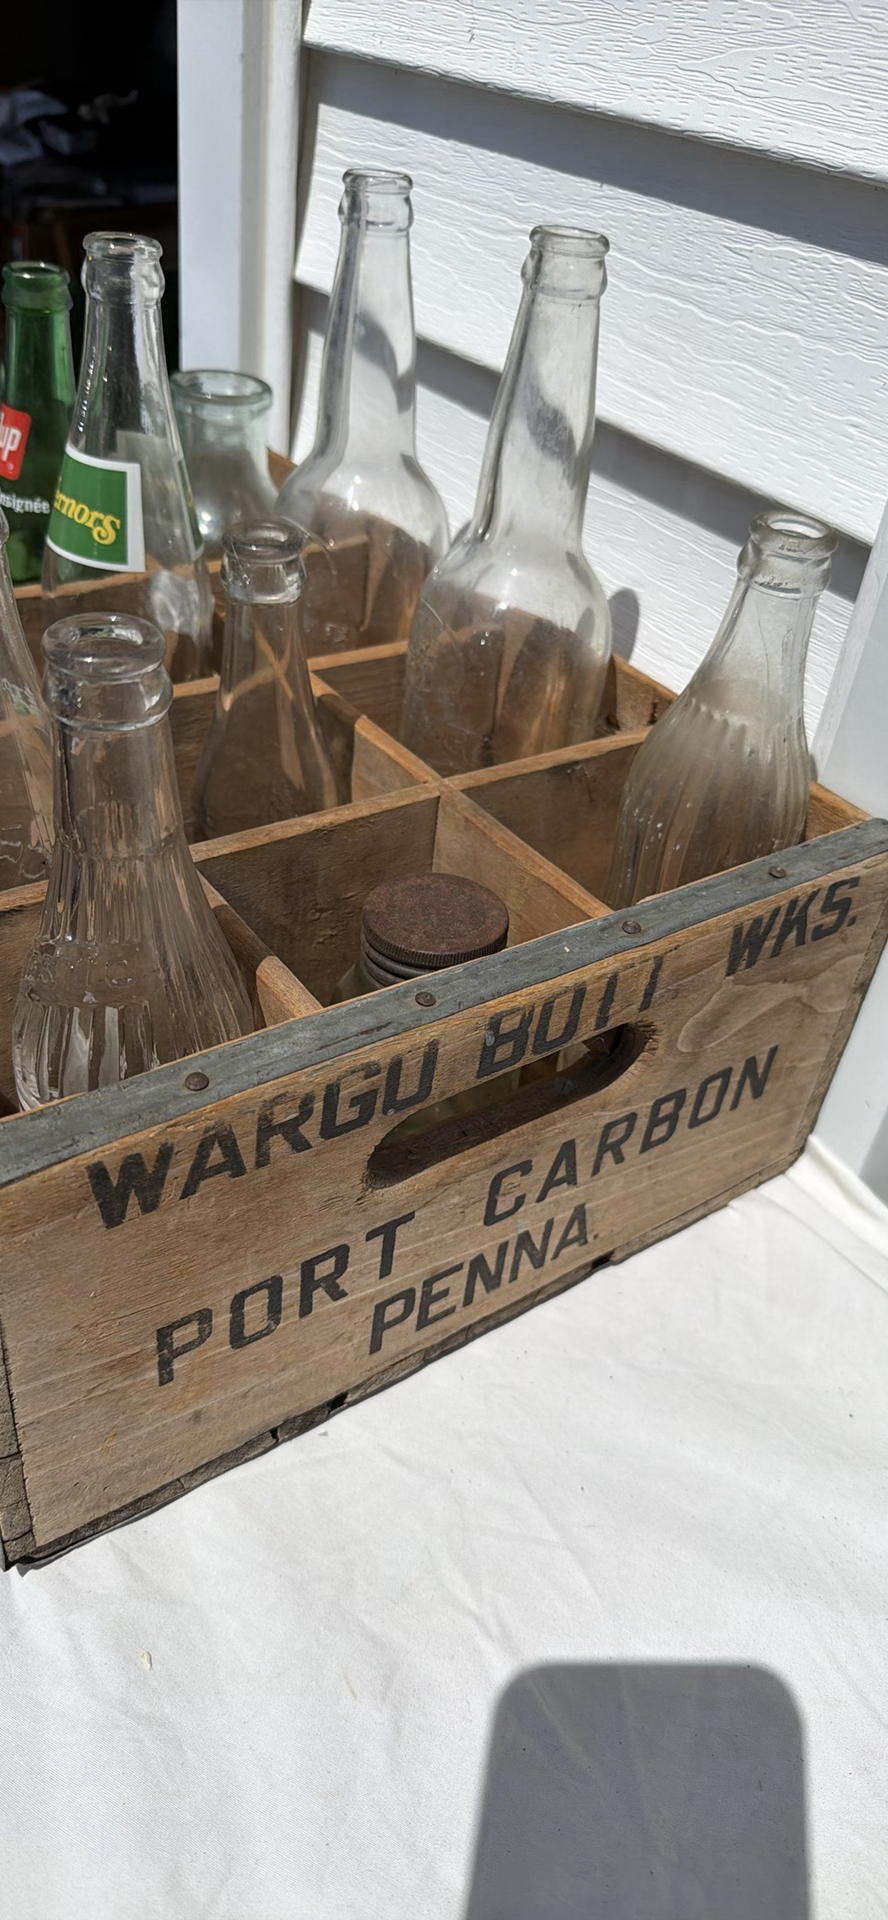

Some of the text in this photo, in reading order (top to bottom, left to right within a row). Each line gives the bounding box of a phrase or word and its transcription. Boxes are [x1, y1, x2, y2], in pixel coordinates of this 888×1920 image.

[53, 488, 121, 545] ernors
[725, 876, 860, 976] WKS.
[156, 1045, 778, 1386] PORT CARBON
[369, 1203, 599, 1355] PENNA.
